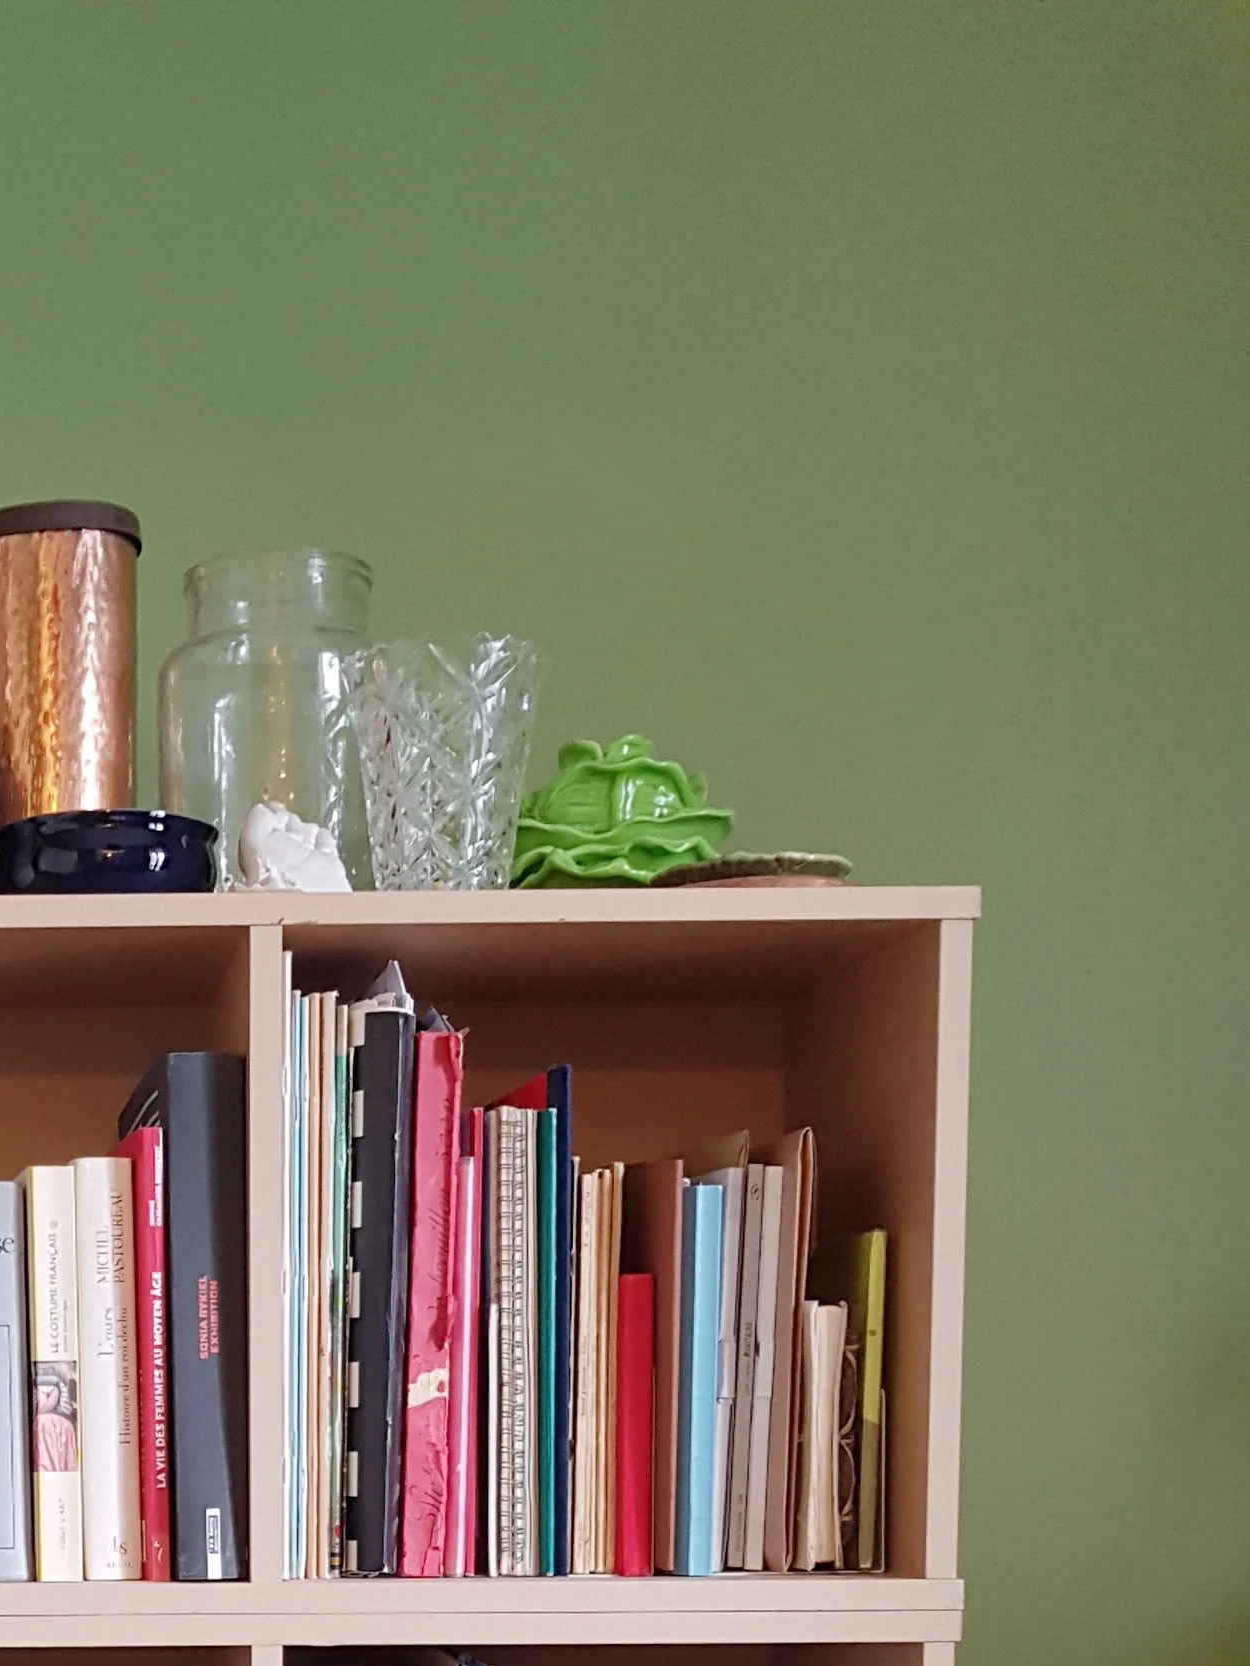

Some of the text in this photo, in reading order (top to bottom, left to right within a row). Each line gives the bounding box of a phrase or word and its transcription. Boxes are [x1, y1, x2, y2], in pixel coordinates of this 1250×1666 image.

[95, 1225, 111, 1285] MICHEL
[109, 1188, 125, 1285] PASTOUREAU
[197, 1276, 209, 1359] SONIA RYKIEL
[208, 1280, 220, 1354] EXHIBITION
[150, 1271, 166, 1488] LA VIE DES FEMMES AU MOYEN ÂGE
